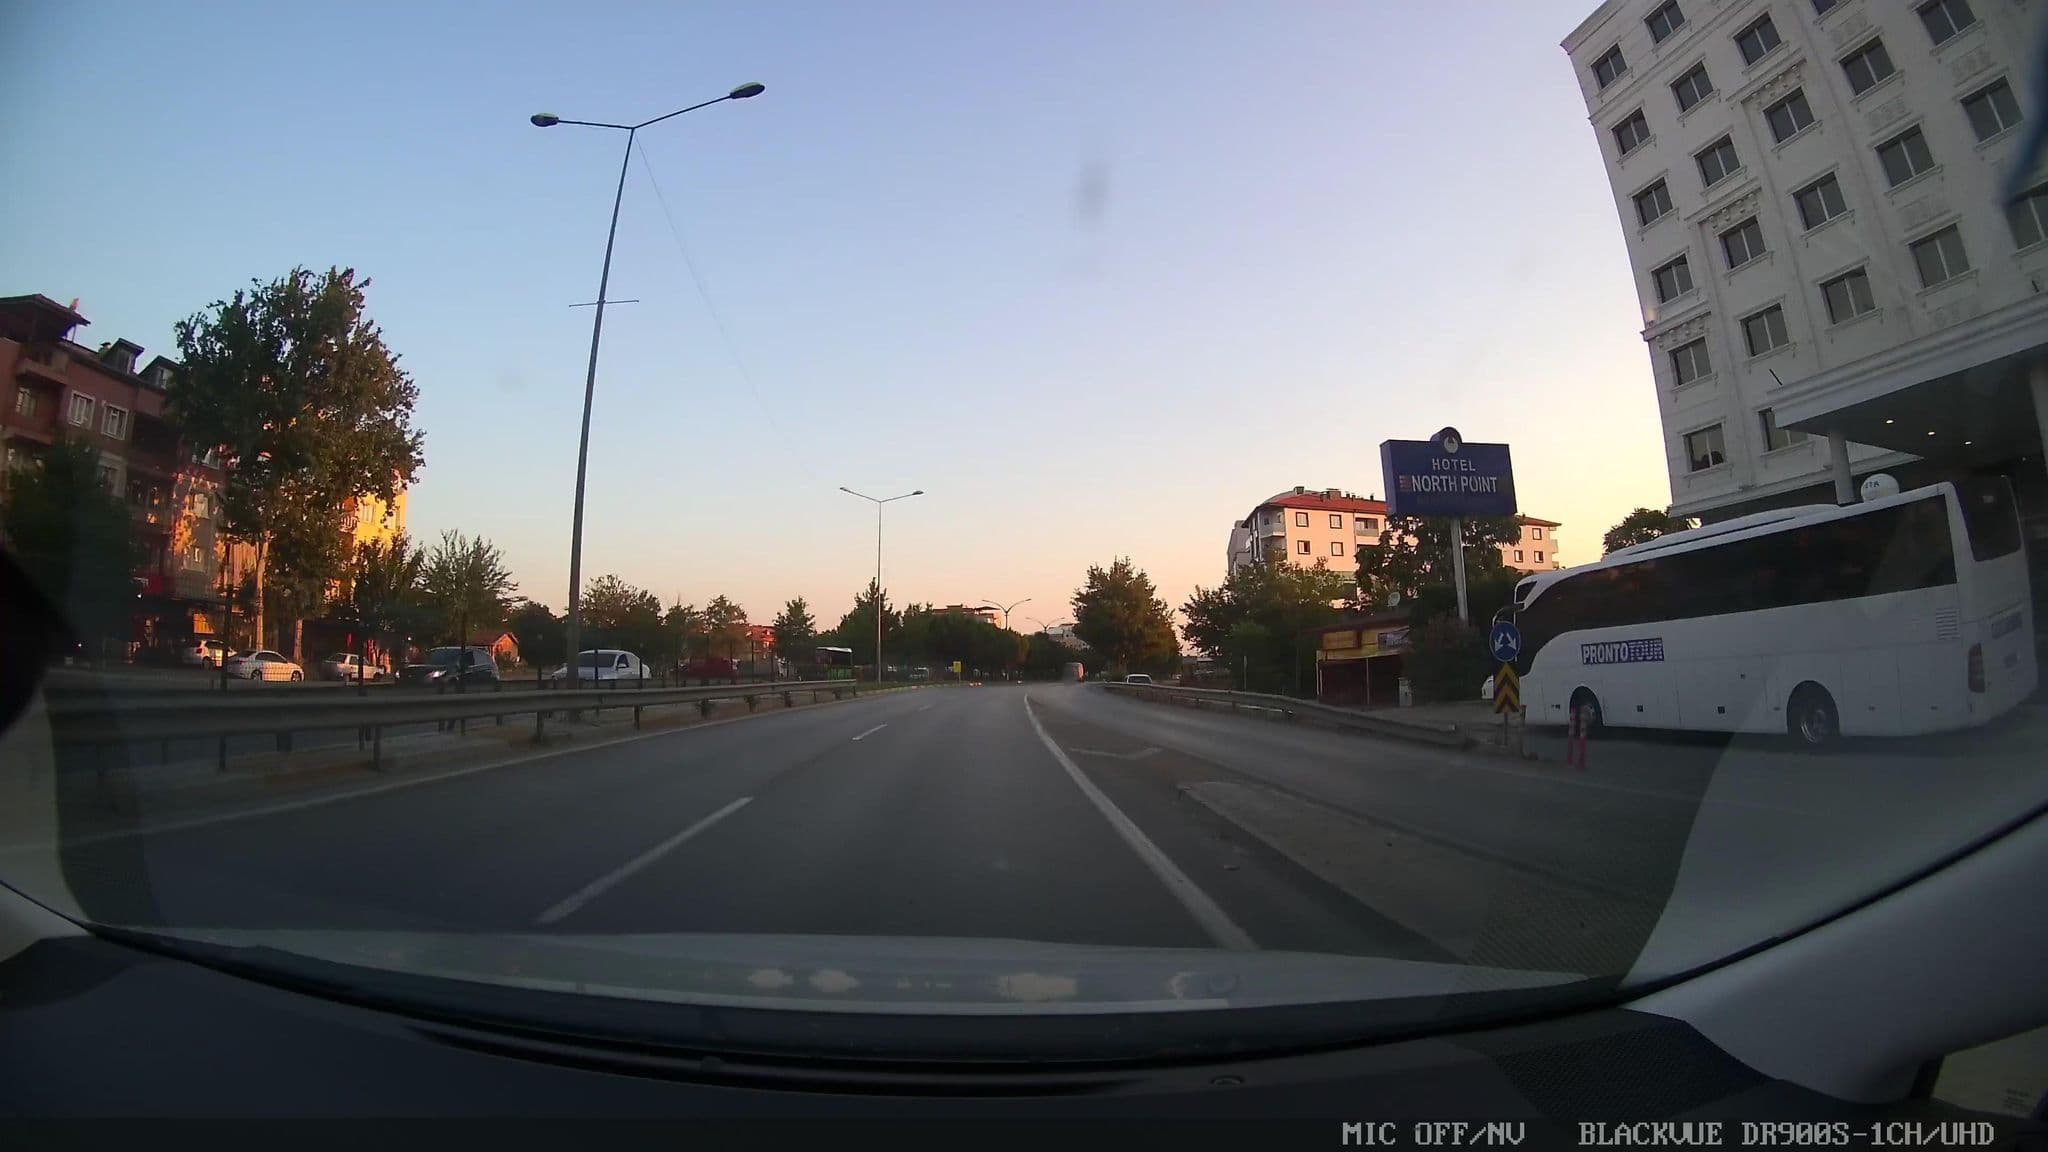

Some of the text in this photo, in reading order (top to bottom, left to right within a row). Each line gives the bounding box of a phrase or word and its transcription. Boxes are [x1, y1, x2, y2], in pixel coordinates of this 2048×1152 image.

[1432, 458, 1476, 472] HOTEL
[1411, 475, 1498, 494] NORTH POINT
